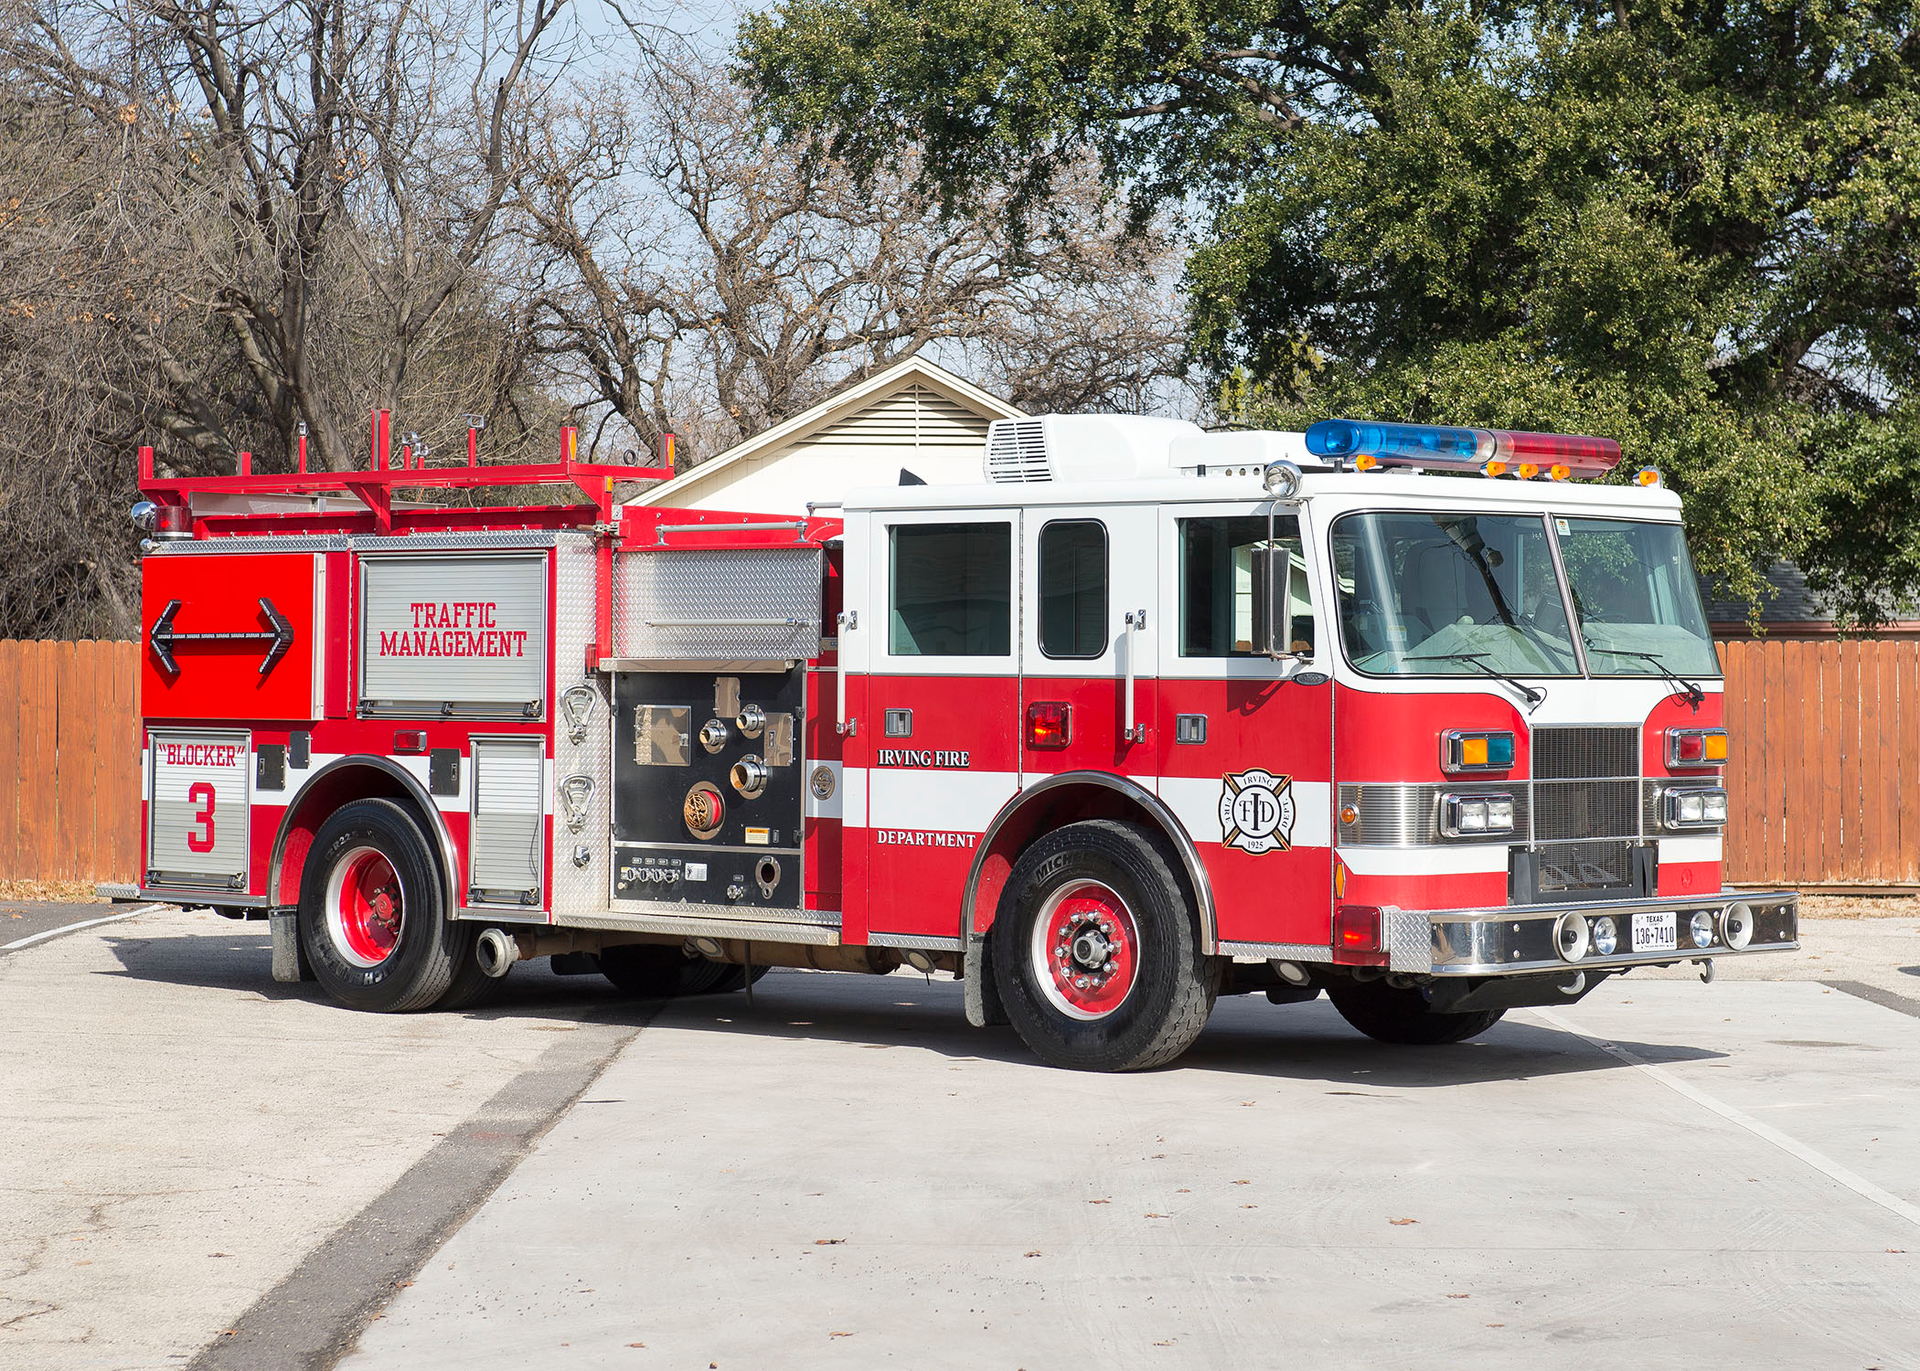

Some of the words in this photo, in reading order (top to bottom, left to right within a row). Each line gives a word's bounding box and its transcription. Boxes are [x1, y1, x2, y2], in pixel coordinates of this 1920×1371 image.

[410, 602, 497, 628] TRAFFIC
[379, 630, 527, 657] MANAGEMENT
[877, 749, 932, 767] IRVING
[933, 750, 970, 768] FIRE
[1243, 775, 1274, 787] IRVING
[187, 781, 216, 853] 3
[877, 830, 976, 848] DEPARTMENT
[1247, 841, 1264, 849] 1925
